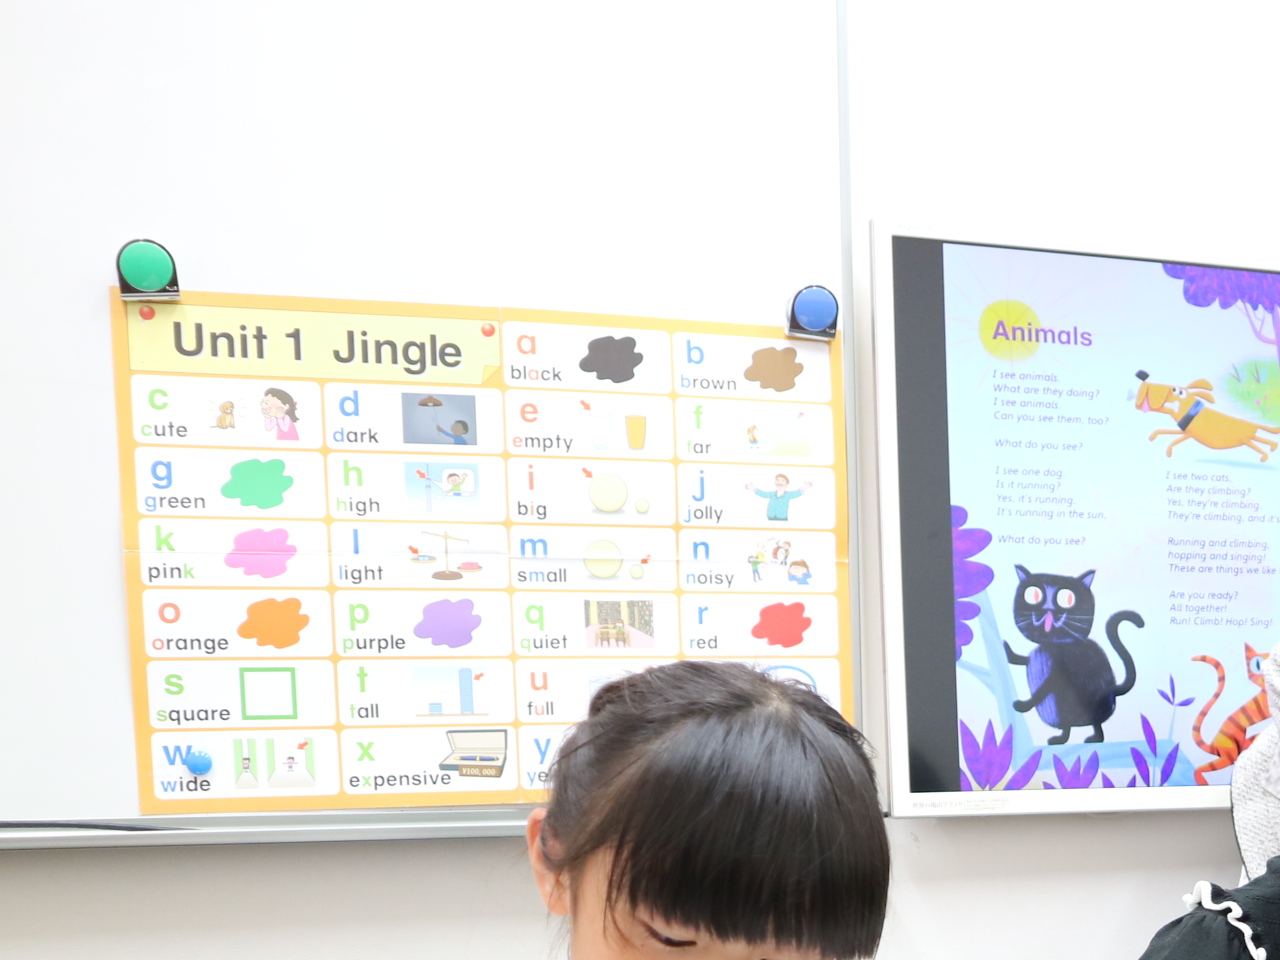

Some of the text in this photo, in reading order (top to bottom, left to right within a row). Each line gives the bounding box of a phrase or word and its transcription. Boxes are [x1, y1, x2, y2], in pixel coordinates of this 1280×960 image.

[992, 320, 1092, 346] Animals
[172, 321, 462, 375] Unit 1 Jingle
[517, 334, 536, 354] a
[686, 339, 704, 364] b
[511, 366, 562, 382] black
[681, 374, 737, 391] brown
[148, 389, 168, 410] c
[339, 391, 359, 417] d
[520, 403, 538, 423] e
[693, 406, 703, 429] f
[141, 422, 188, 437] cute
[333, 428, 379, 443] dark
[513, 434, 573, 452] empty
[687, 440, 711, 454] far
[151, 461, 172, 489] g
[344, 460, 362, 486] h
[528, 464, 534, 490] i
[692, 470, 705, 501] j
[145, 496, 205, 512] green
[337, 497, 380, 515] high
[518, 502, 547, 520] big
[684, 506, 723, 523] jolly
[155, 525, 176, 552] k
[520, 538, 548, 559] m
[693, 541, 710, 560] n
[148, 564, 194, 582] pink
[339, 565, 383, 584] light
[518, 569, 566, 583] small
[686, 572, 734, 588] noisy
[158, 603, 180, 623] o
[349, 603, 369, 631] p
[525, 605, 544, 631] q
[698, 606, 708, 624] r
[152, 637, 229, 654] orange
[343, 635, 405, 653] purple
[520, 636, 567, 653] quiet
[690, 636, 718, 649] red
[164, 674, 184, 695] s
[357, 667, 368, 692] t
[531, 671, 548, 691] u
[157, 706, 230, 725] square
[350, 703, 379, 718] tall
[528, 701, 554, 716] full
[356, 741, 375, 762] x
[533, 738, 551, 765] y
[160, 776, 211, 792] wide
[349, 772, 451, 790] expensive
